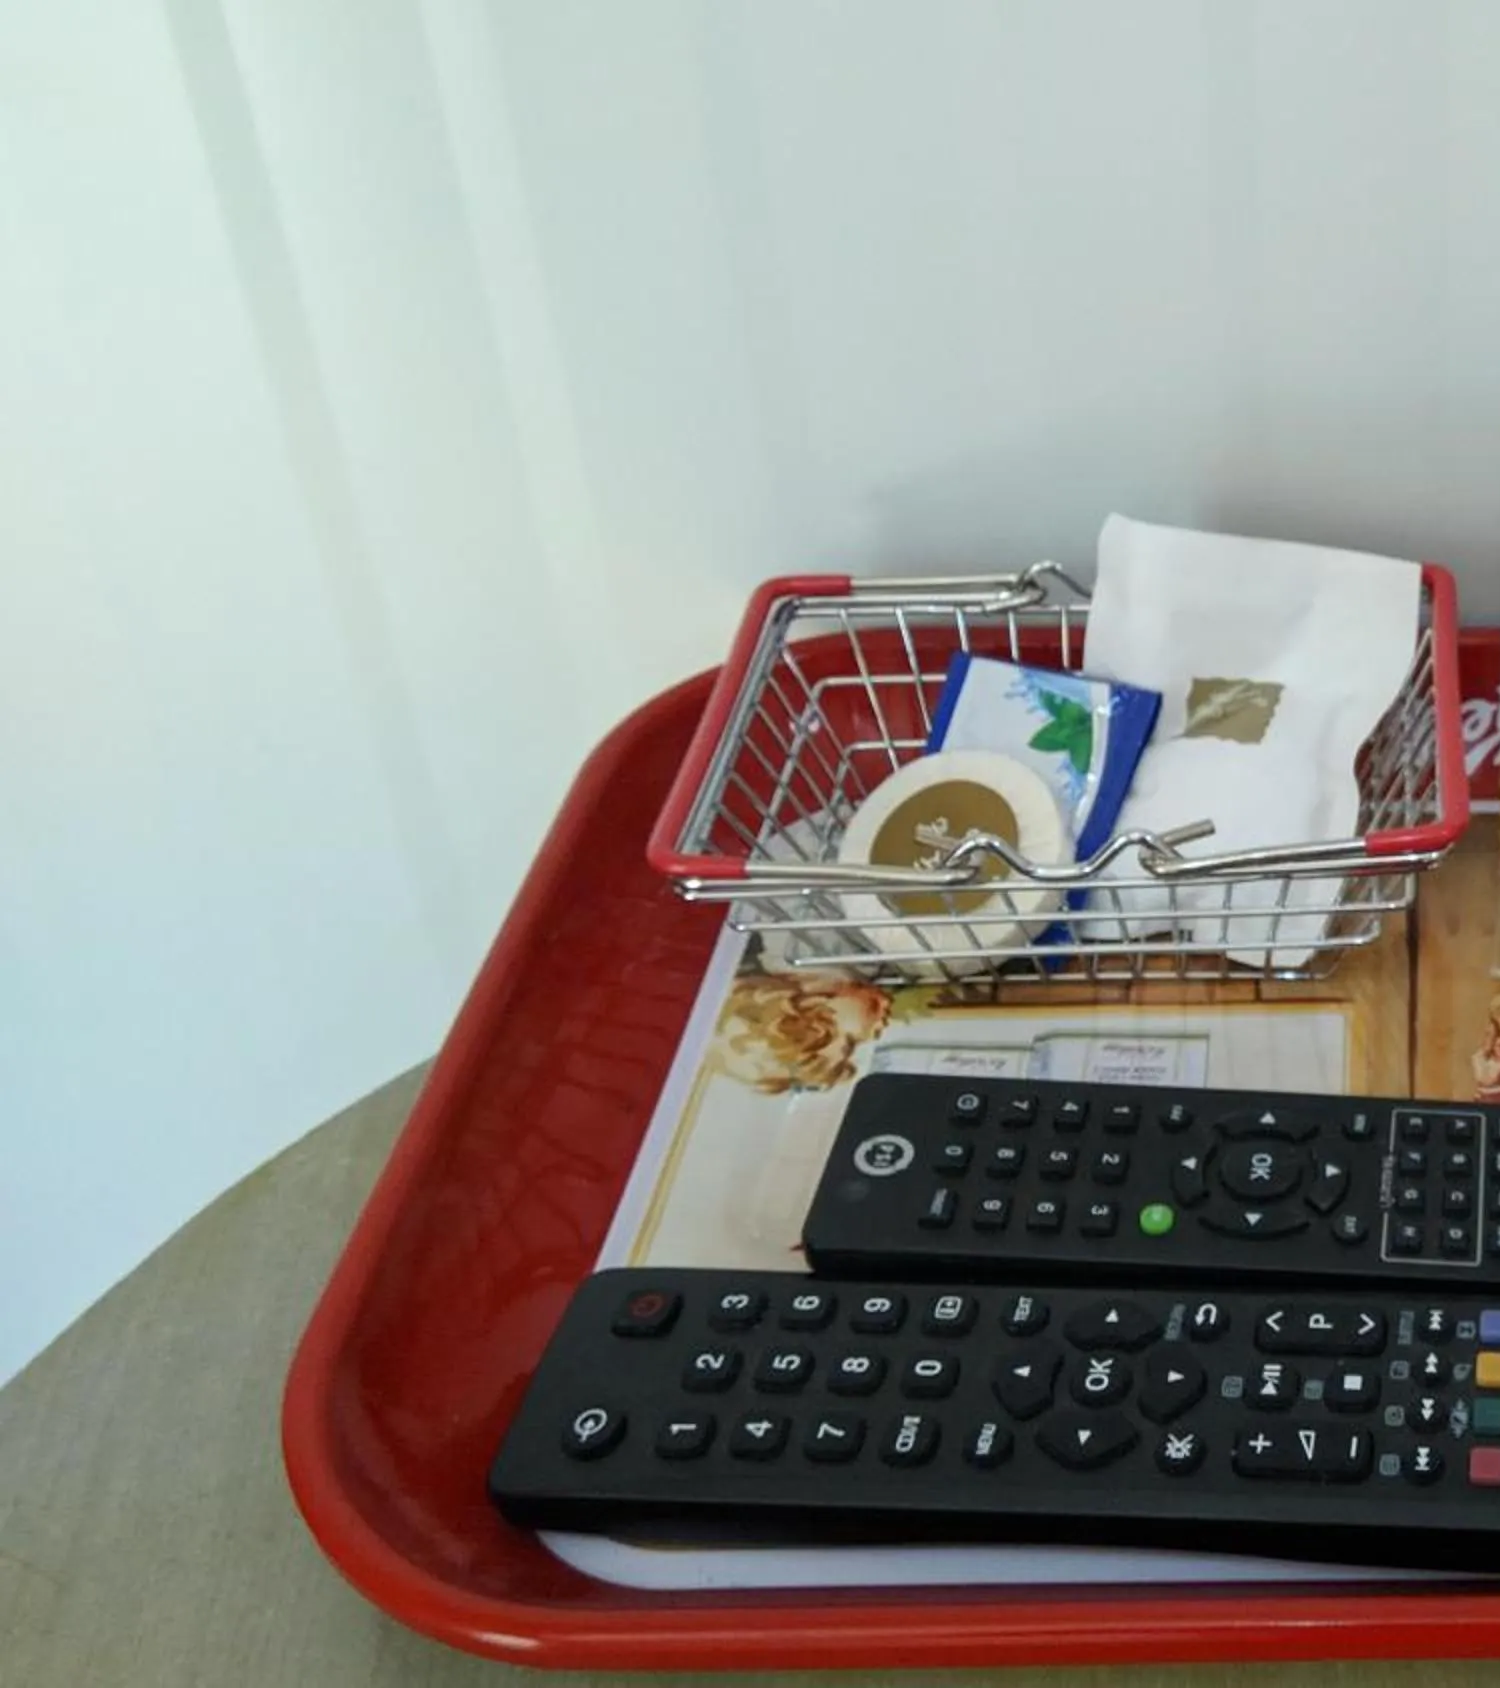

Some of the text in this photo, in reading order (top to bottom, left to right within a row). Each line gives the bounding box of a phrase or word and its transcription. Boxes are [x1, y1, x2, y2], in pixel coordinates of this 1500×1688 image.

[1249, 1152, 1274, 1182] OK
[720, 1293, 750, 1309] 3
[792, 1295, 821, 1310] 6
[863, 1297, 892, 1313] 9
[1308, 1313, 1334, 1329] P
[695, 1353, 725, 1370] 2
[772, 1354, 801, 1371] 5
[841, 1356, 870, 1373] 8
[1085, 1358, 1114, 1391] OK
[669, 1422, 698, 1436] 1
[744, 1419, 774, 1438] 4
[816, 1421, 846, 1440] 7
